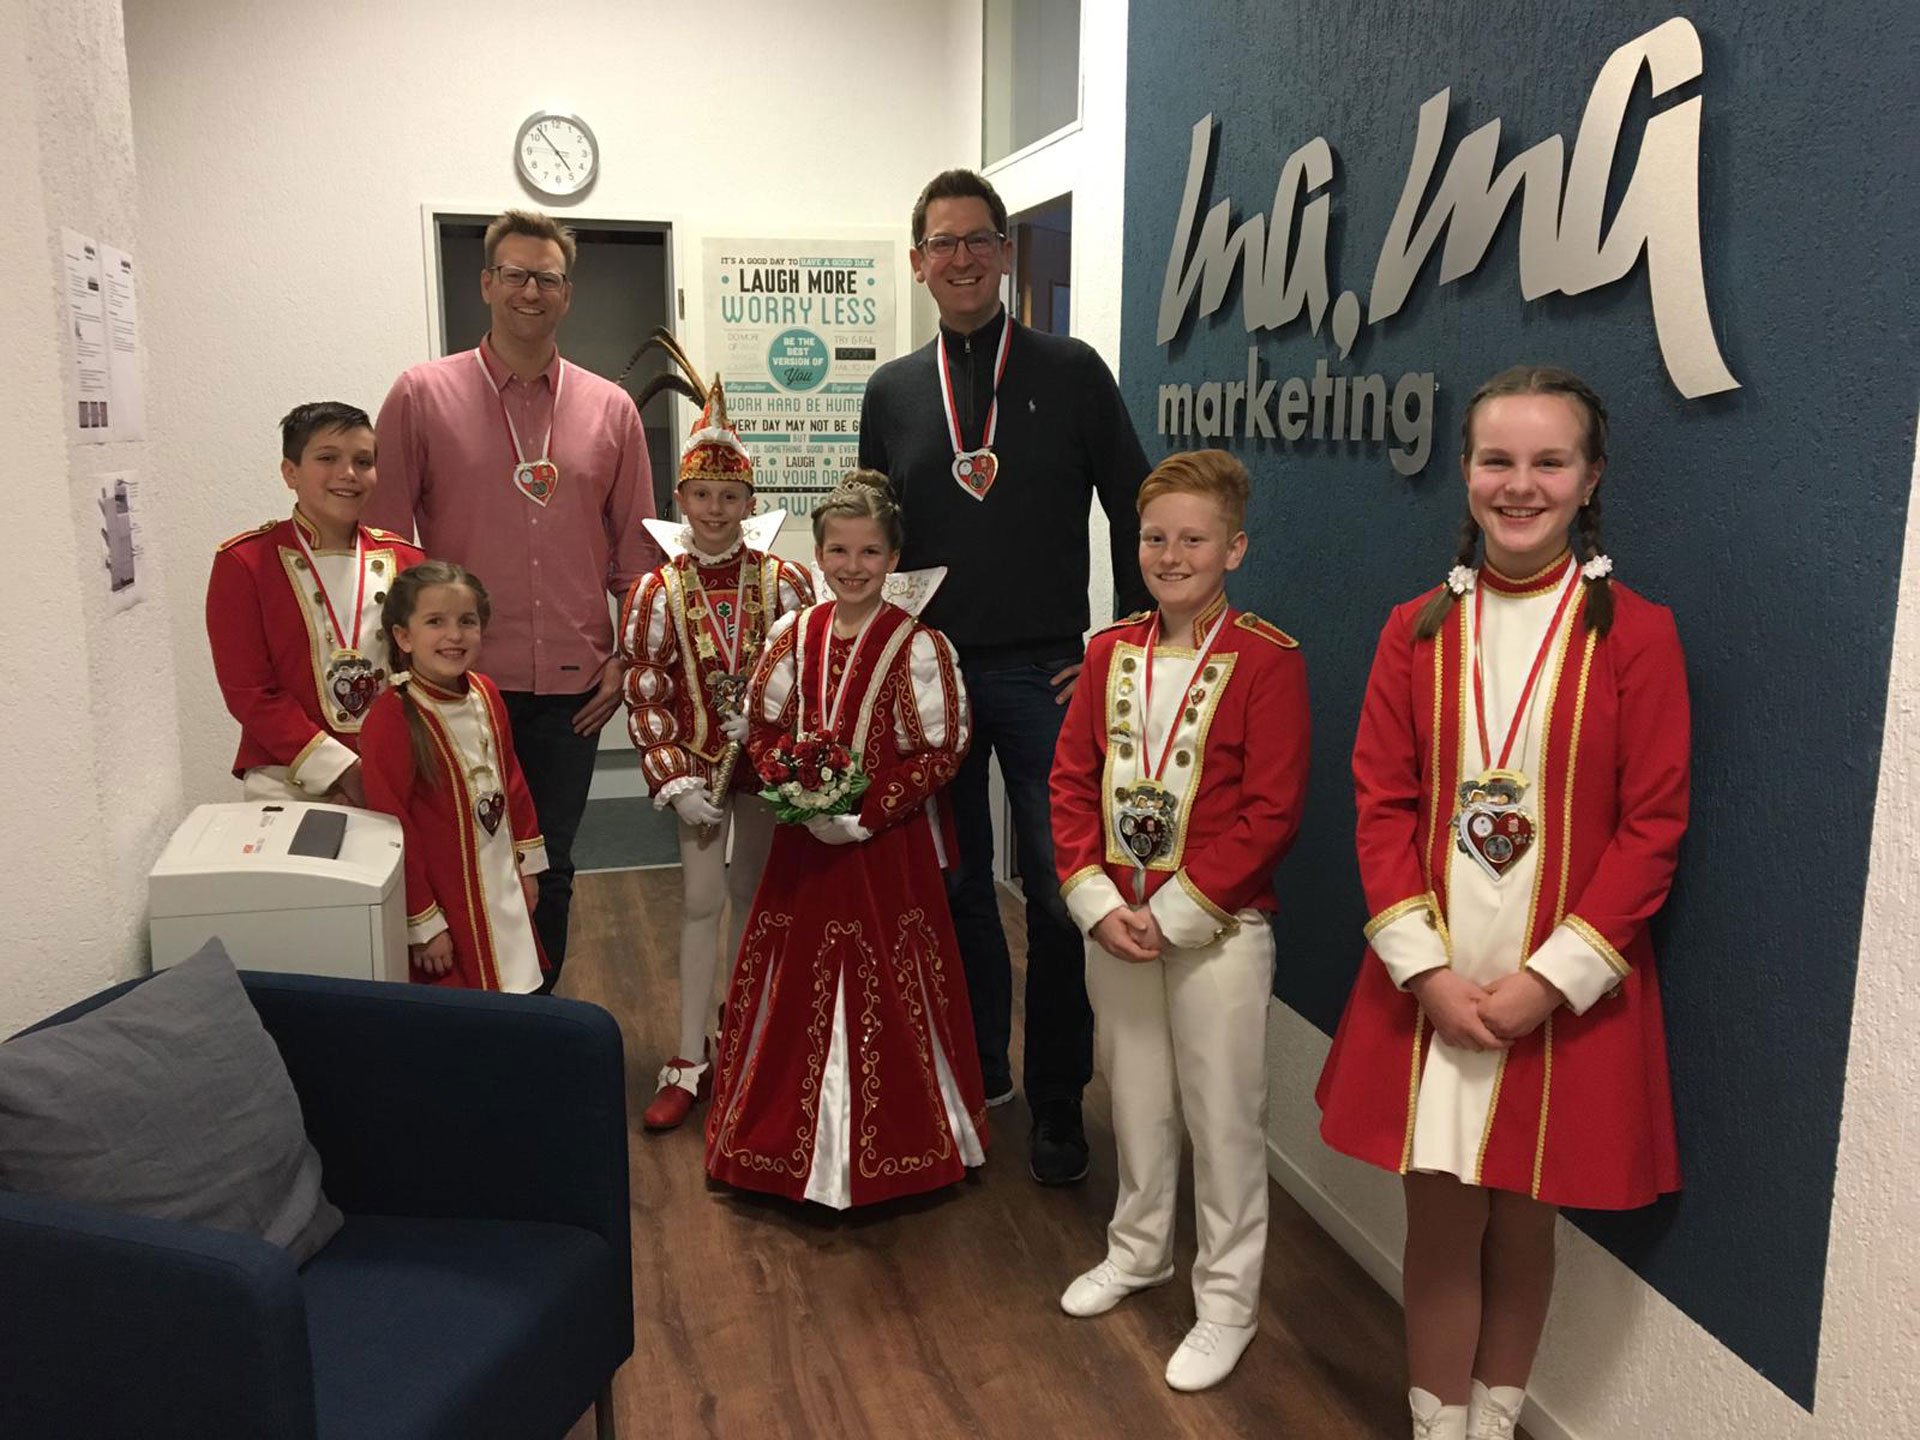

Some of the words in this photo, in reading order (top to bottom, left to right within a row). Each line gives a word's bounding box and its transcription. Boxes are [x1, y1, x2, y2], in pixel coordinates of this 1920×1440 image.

[551, 119, 561, 129] 12
[531, 133, 541, 142] 10
[576, 135, 583, 144] 2
[526, 146, 533, 155] 9
[581, 150, 588, 158] 3
[578, 162, 584, 170] 4
[543, 171, 549, 179] 7
[555, 175, 562, 183] 6
[568, 173, 574, 181] 5
[721, 257, 736, 265] IT'S
[739, 257, 745, 265] A
[747, 257, 768, 265] GOOD
[770, 258, 785, 266] DAY
[788, 258, 798, 266] TO
[801, 258, 822, 266] HAVE
[739, 268, 800, 293] LAUGH
[808, 270, 857, 294] MORE
[722, 295, 812, 324] WORRY
[821, 297, 876, 325] LESS
[783, 337, 795, 346] BE
[798, 337, 815, 347] THE
[787, 347, 809, 356] BEST
[772, 357, 810, 366] VERSION
[812, 357, 824, 366] OF
[784, 367, 814, 386] You
[725, 397, 762, 412] WORK
[768, 398, 801, 412] HARD
[806, 398, 820, 412] BE
[826, 398, 863, 412] HUMB
[1157, 346, 1435, 477] marketing
[732, 420, 757, 432] VERY
[762, 420, 781, 432] DAY
[786, 420, 806, 432] MAY
[810, 420, 829, 432] NOT
[834, 420, 847, 432] BE
[792, 433, 807, 443] BUT
[764, 445, 802, 454] SOMETHING
[807, 445, 824, 454] GOOD
[839, 445, 858, 454] EVER
[750, 456, 762, 467] VE
[786, 456, 815, 468] LAUGH
[840, 457, 858, 468] LOV
[783, 470, 817, 486] YOUR
